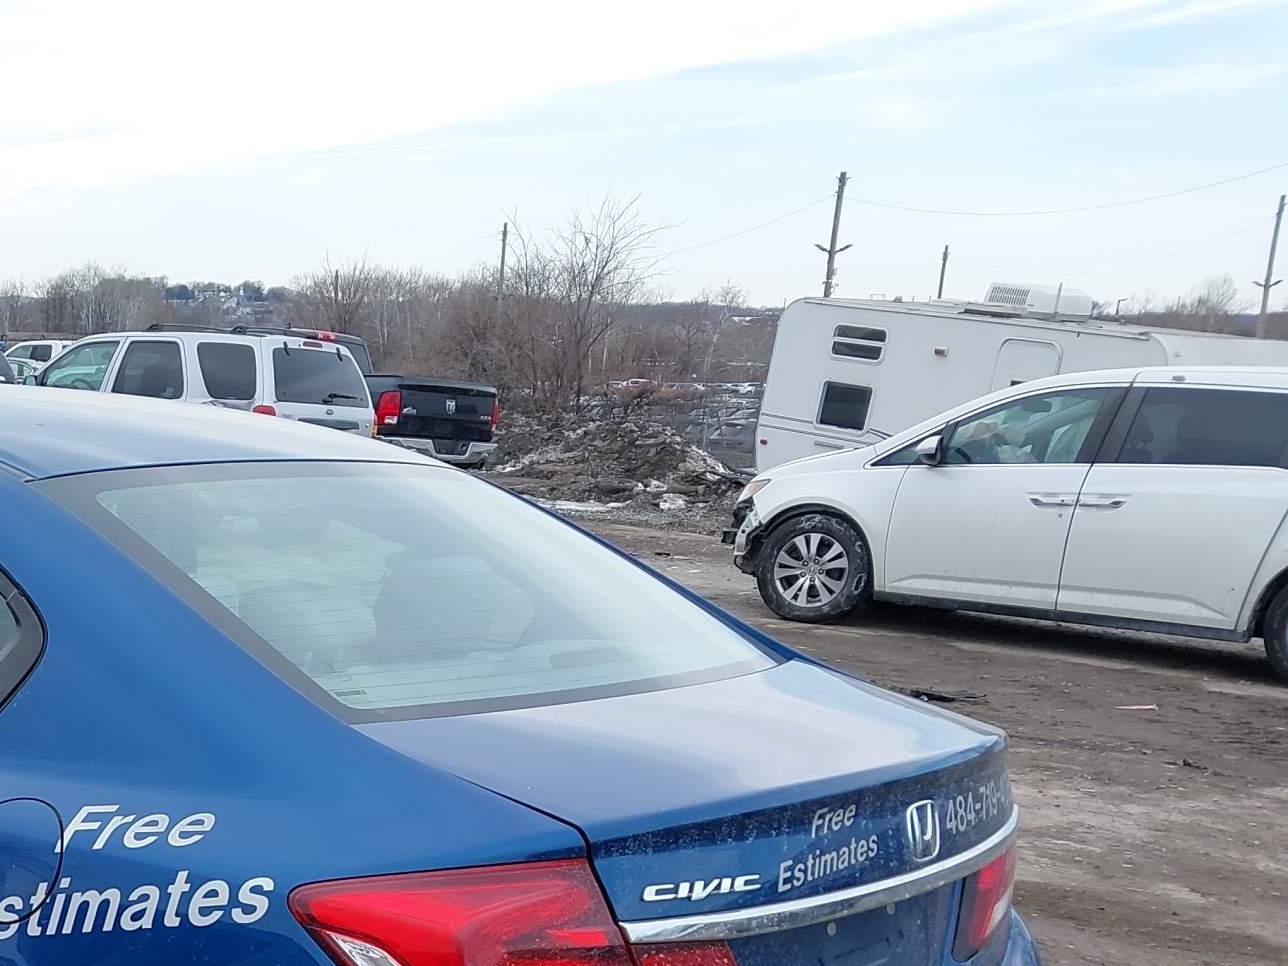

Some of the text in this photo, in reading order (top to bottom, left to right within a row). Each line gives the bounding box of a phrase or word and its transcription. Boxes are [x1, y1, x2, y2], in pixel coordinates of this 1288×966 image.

[53, 804, 216, 853] Free
[811, 803, 857, 838] Free
[776, 834, 879, 893] Estimates
[642, 874, 762, 902] CIVIC
